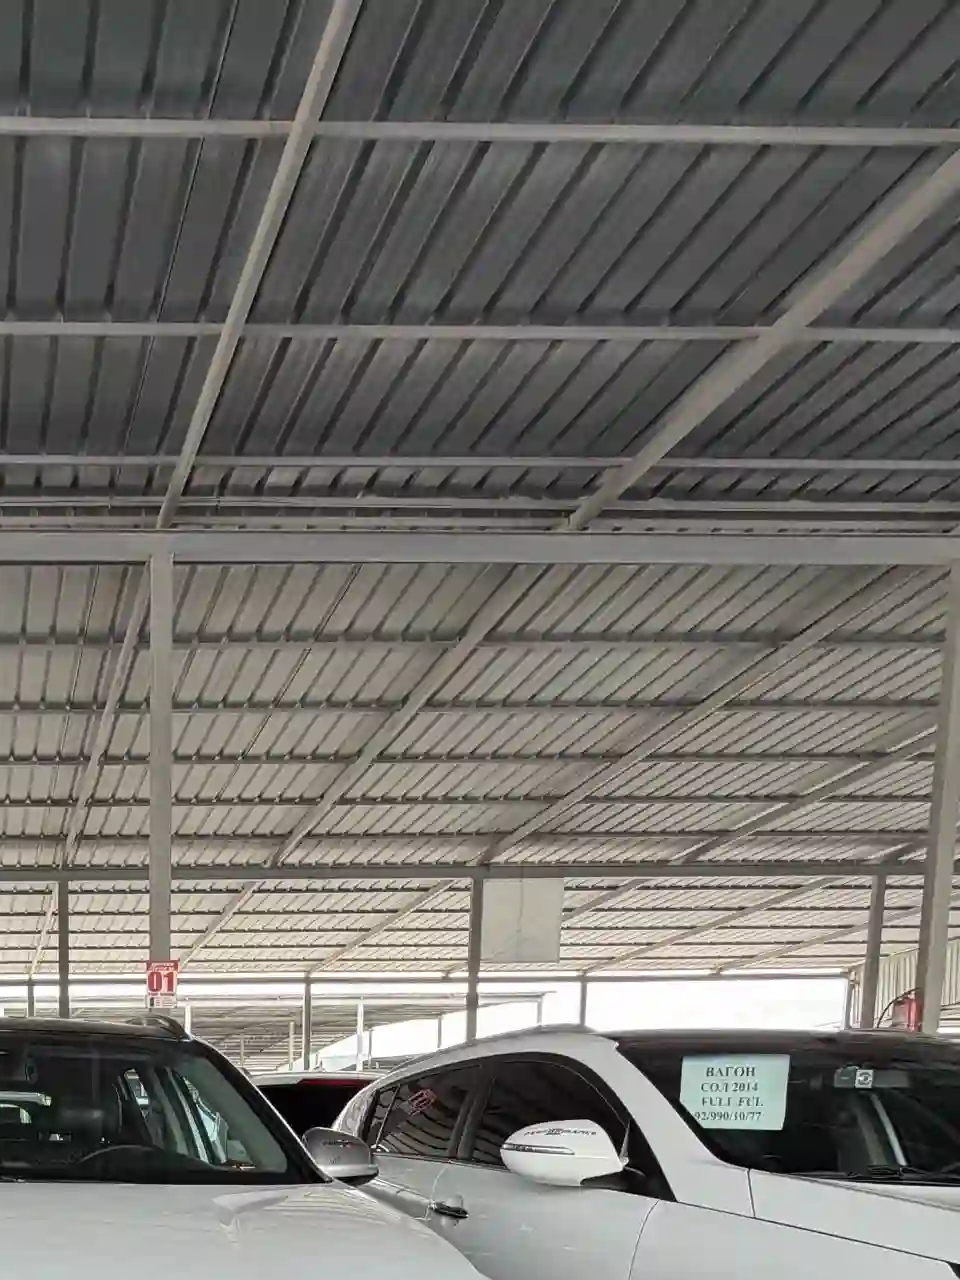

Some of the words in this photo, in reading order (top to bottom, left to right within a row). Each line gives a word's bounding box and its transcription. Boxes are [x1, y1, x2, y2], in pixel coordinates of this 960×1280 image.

[147, 971, 174, 993] 01
[706, 1067, 756, 1078] ВАГОН
[731, 1082, 759, 1092] 2014
